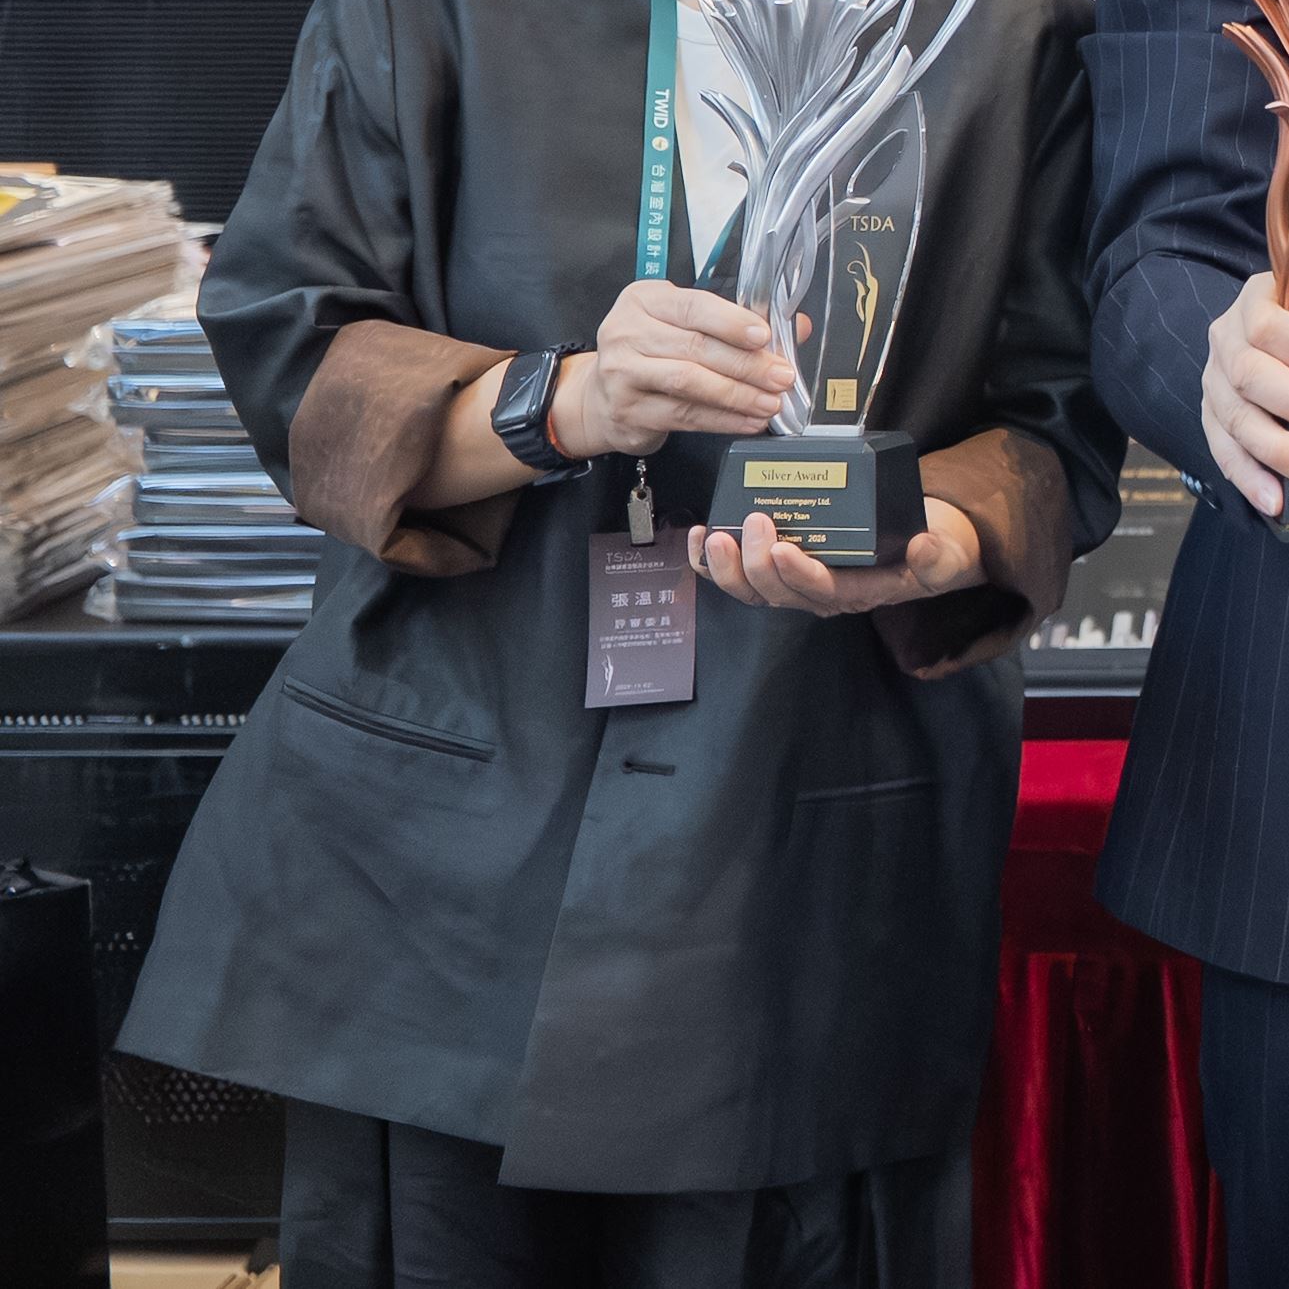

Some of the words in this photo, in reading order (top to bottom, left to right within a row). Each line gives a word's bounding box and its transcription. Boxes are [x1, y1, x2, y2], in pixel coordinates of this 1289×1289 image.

[654, 88, 670, 128] TWID
[850, 215, 895, 232] TSDA
[761, 469, 791, 482] Silver
[793, 469, 829, 482] Award
[783, 498, 817, 507] company
